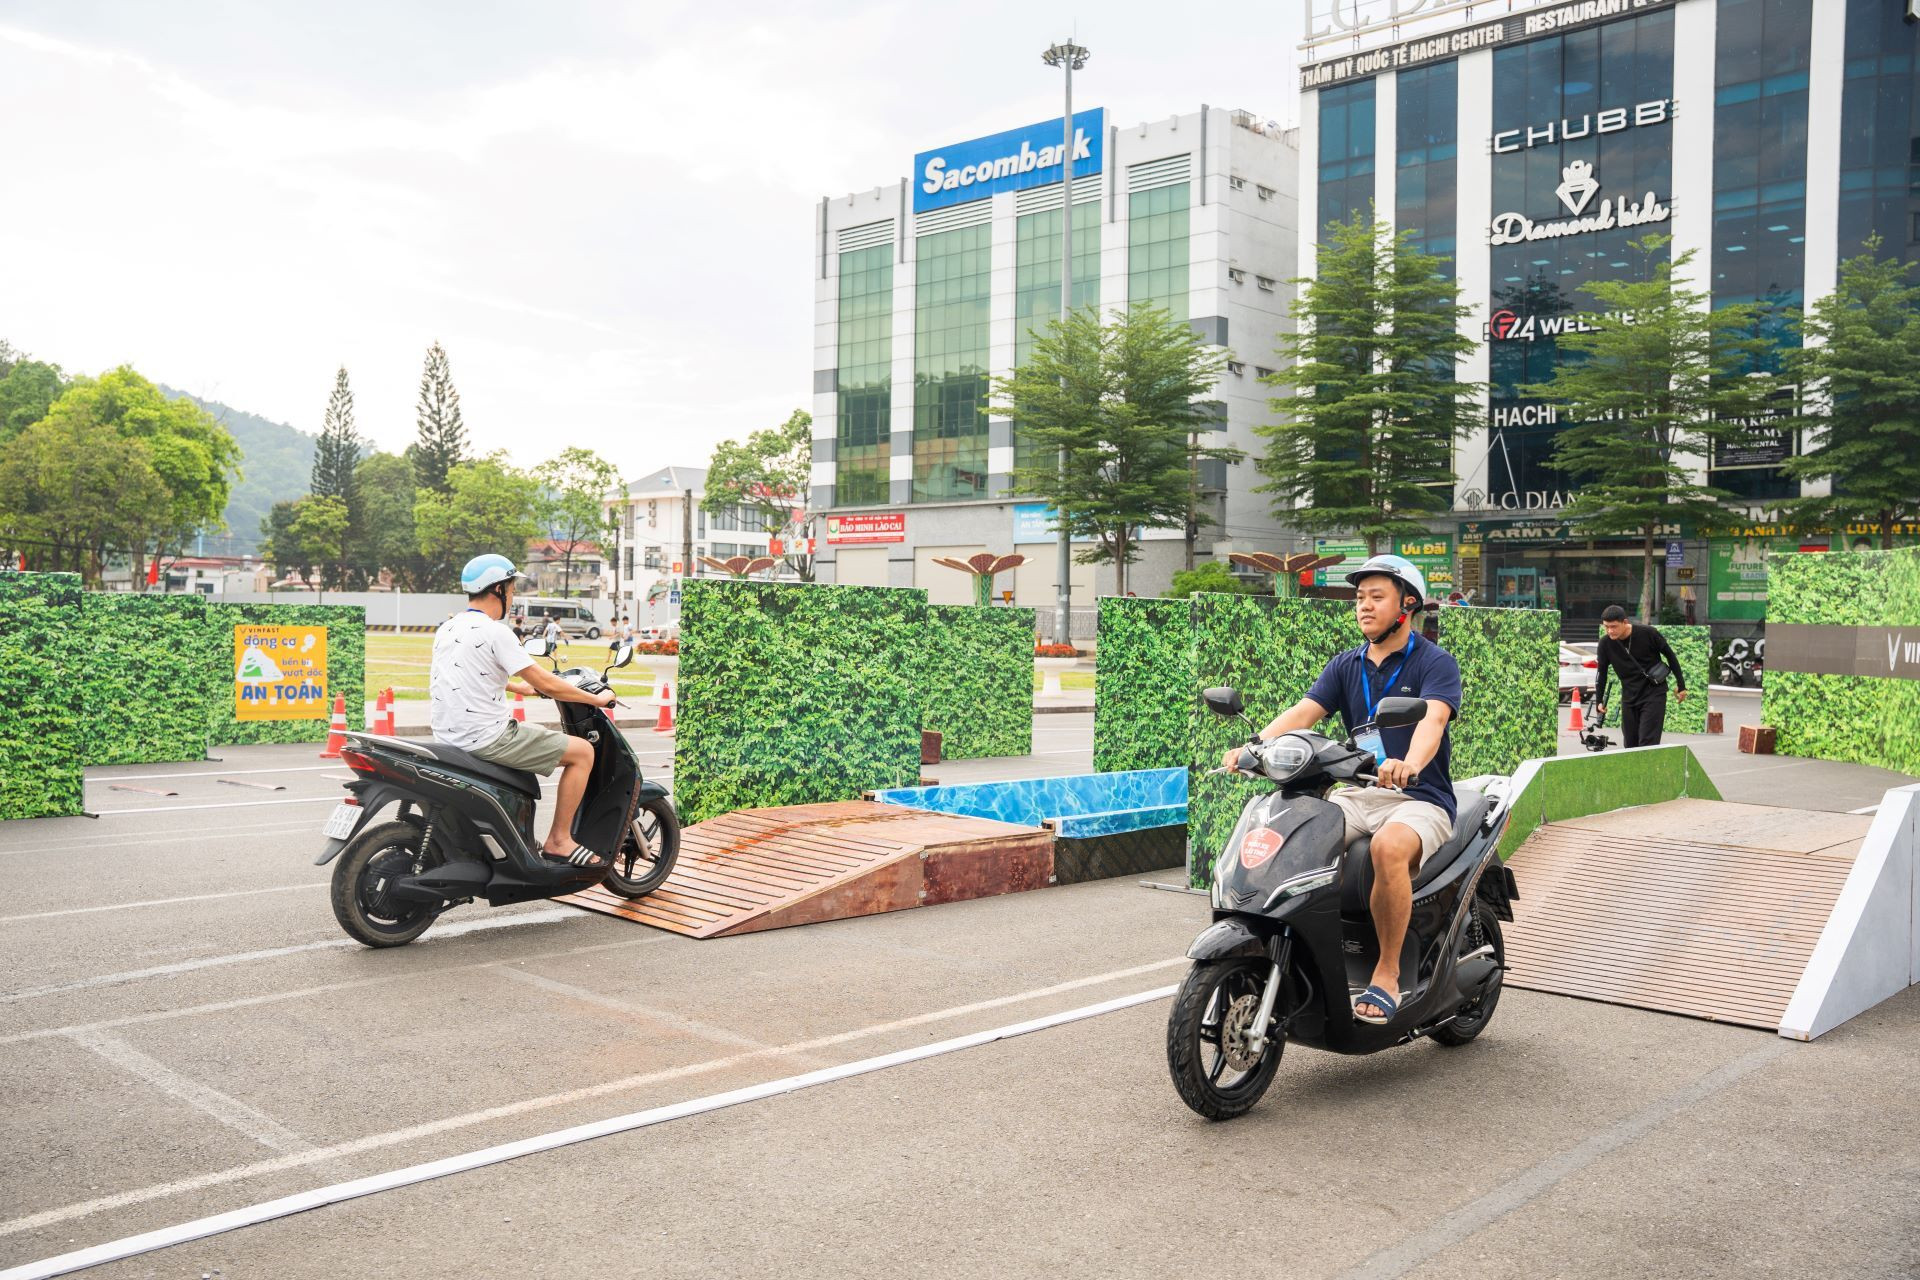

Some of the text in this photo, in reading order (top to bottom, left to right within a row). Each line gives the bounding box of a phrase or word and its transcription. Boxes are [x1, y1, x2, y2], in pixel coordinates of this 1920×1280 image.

[1356, 48, 1389, 75] QUỐC
[1392, 42, 1408, 65] TẾ
[1410, 37, 1449, 62] HACHI
[1451, 23, 1504, 51] CENTER
[1494, 99, 1667, 153] CHUBB
[922, 128, 1092, 194] Sacombank
[1490, 191, 1670, 245] Diamond kids
[1494, 405, 1557, 428] HACHI
[855, 523, 874, 532] MINH
[875, 521, 889, 531] LÀO
[890, 522, 902, 531] CAI
[1488, 528, 1563, 539] ARMY
[1846, 523, 1901, 535] LUYN
[1427, 571, 1453, 582] 50%
[244, 634, 297, 649] động cơ
[241, 681, 323, 700] AN TOÀN
[1412, 895, 1437, 909] INFAST
